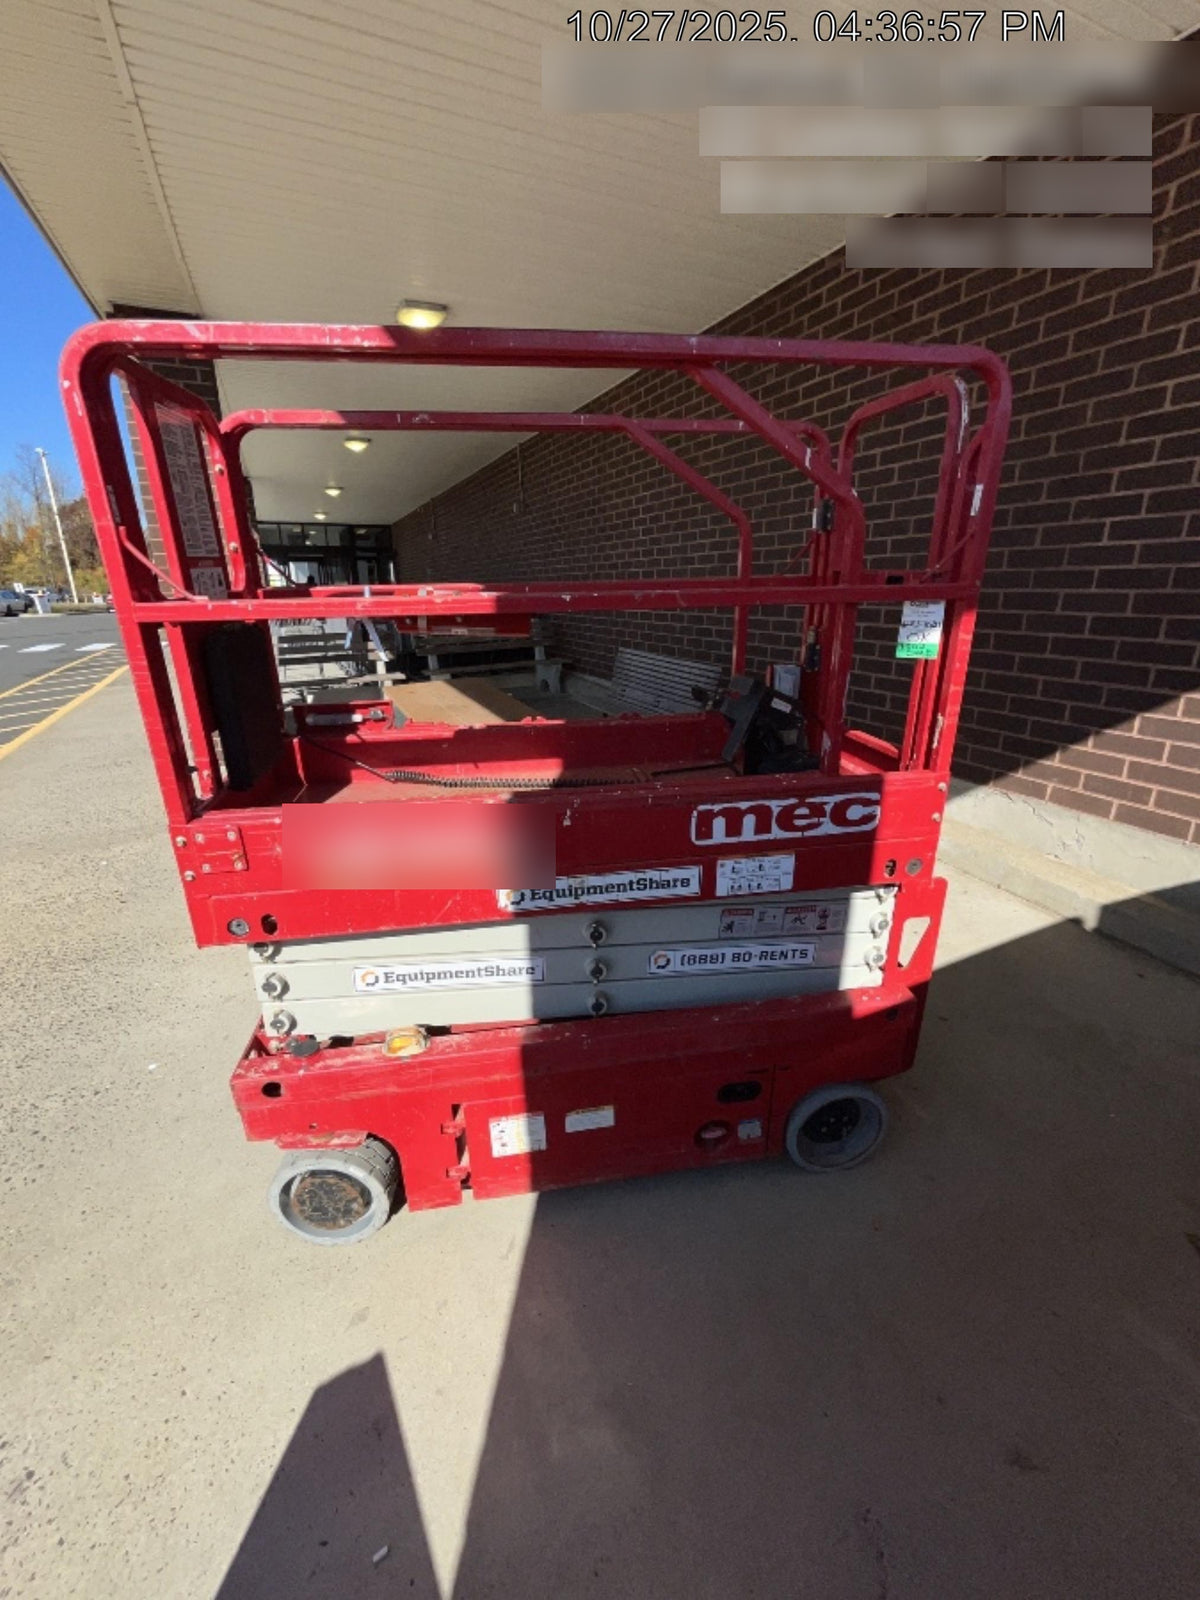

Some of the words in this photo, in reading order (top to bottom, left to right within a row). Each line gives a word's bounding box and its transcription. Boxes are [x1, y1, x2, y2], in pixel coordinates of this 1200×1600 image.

[530, 876, 692, 902] EquipmentShare
[680, 952, 726, 967] (888)
[731, 948, 809, 963] 80-RENTS
[383, 964, 537, 985] EquipmentShare
